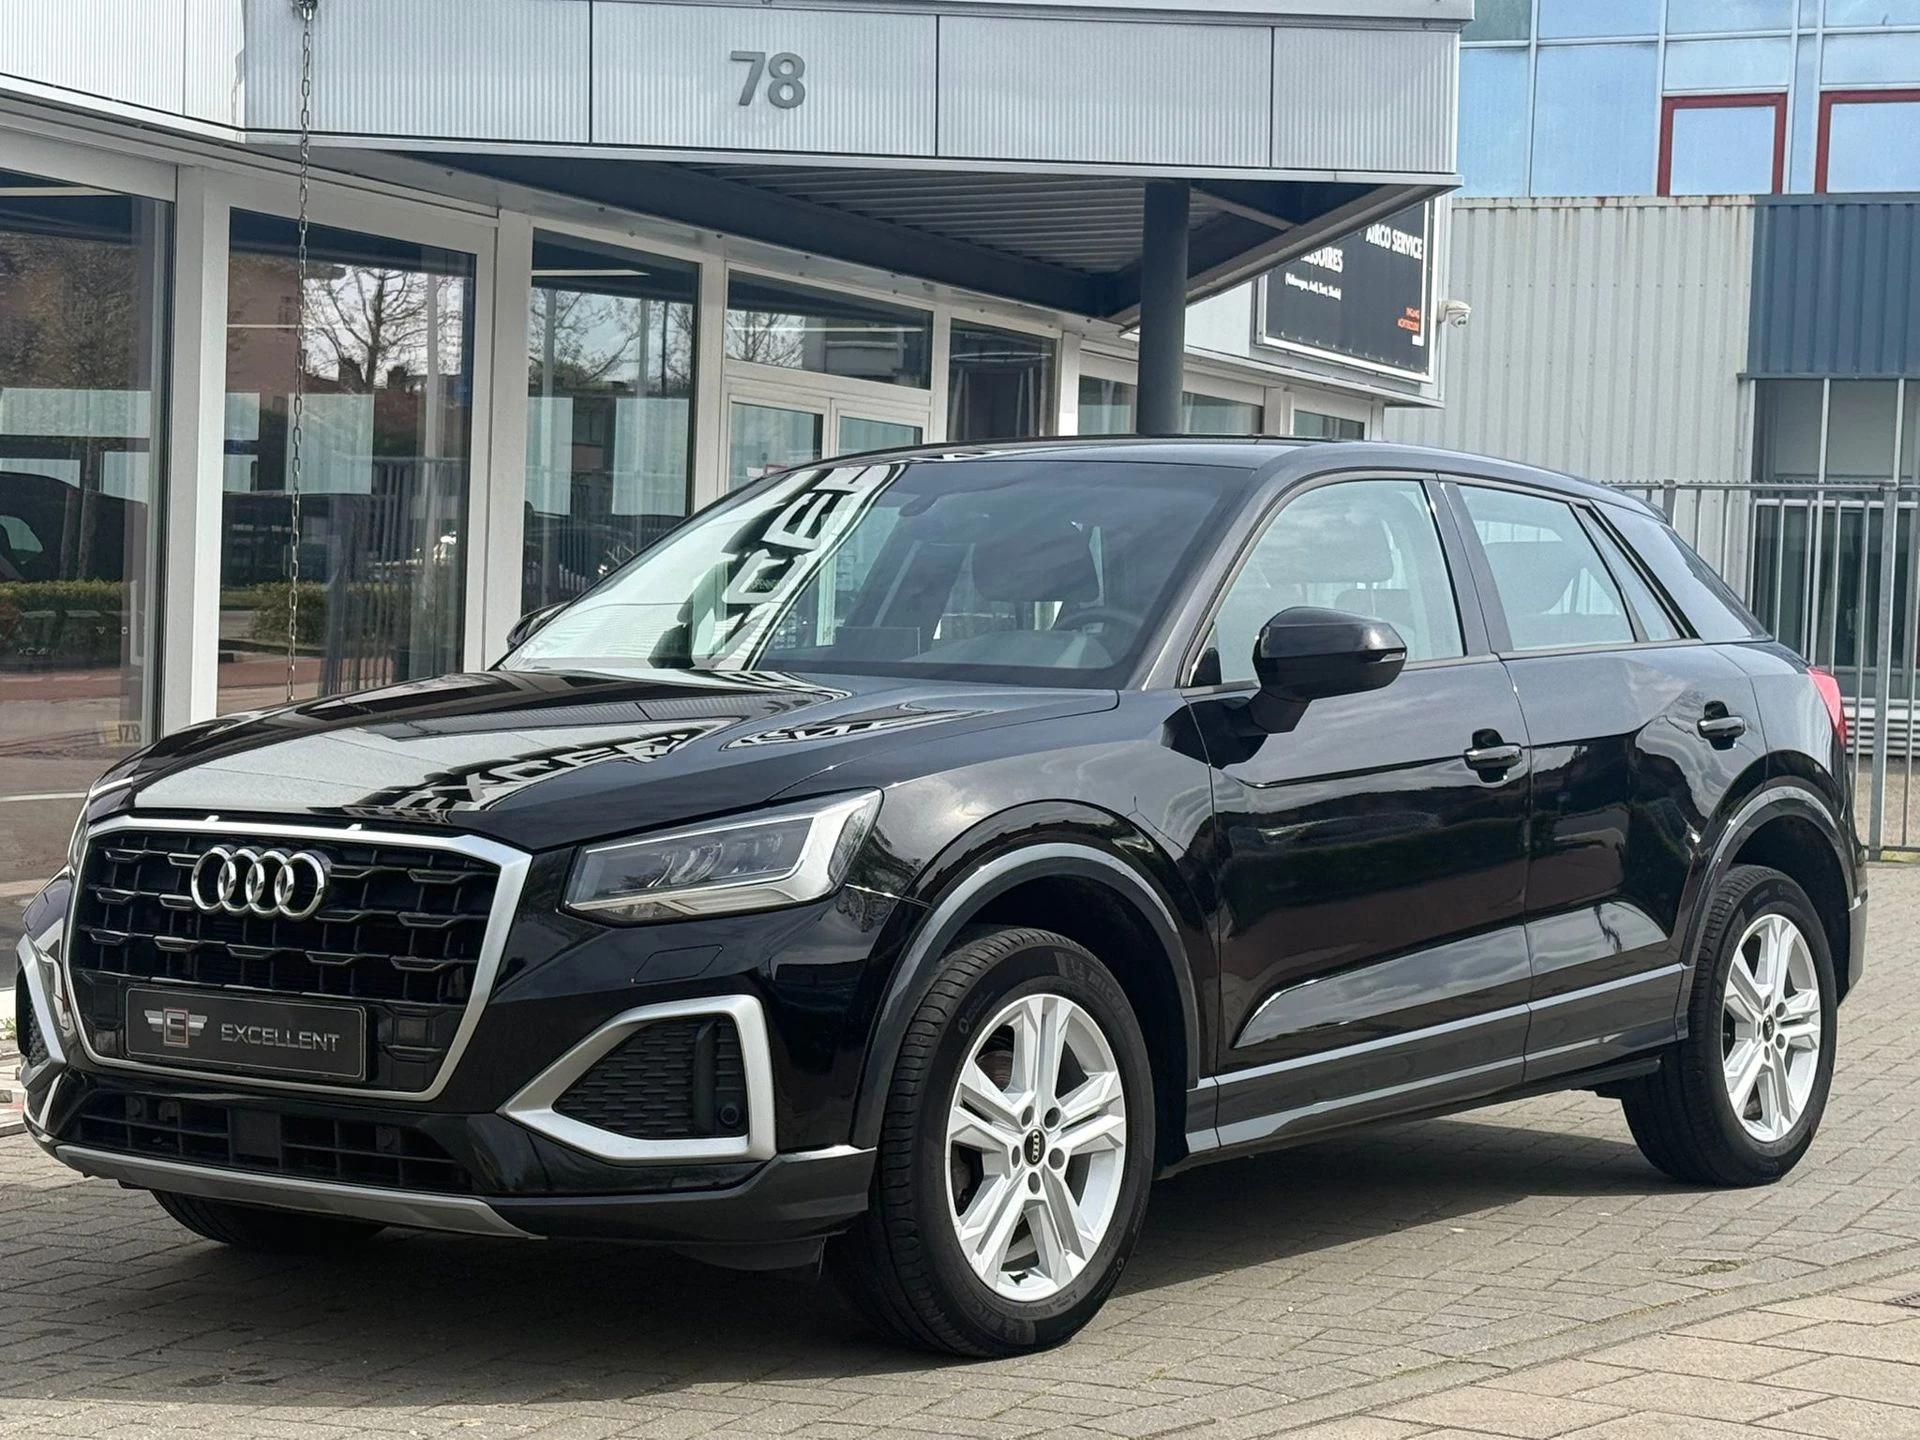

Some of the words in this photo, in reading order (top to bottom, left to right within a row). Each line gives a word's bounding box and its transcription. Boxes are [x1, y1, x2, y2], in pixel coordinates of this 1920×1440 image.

[730, 50, 806, 109] 78
[1391, 229, 1423, 260] SERVICE
[220, 1022, 341, 1053] EXCELLENT
